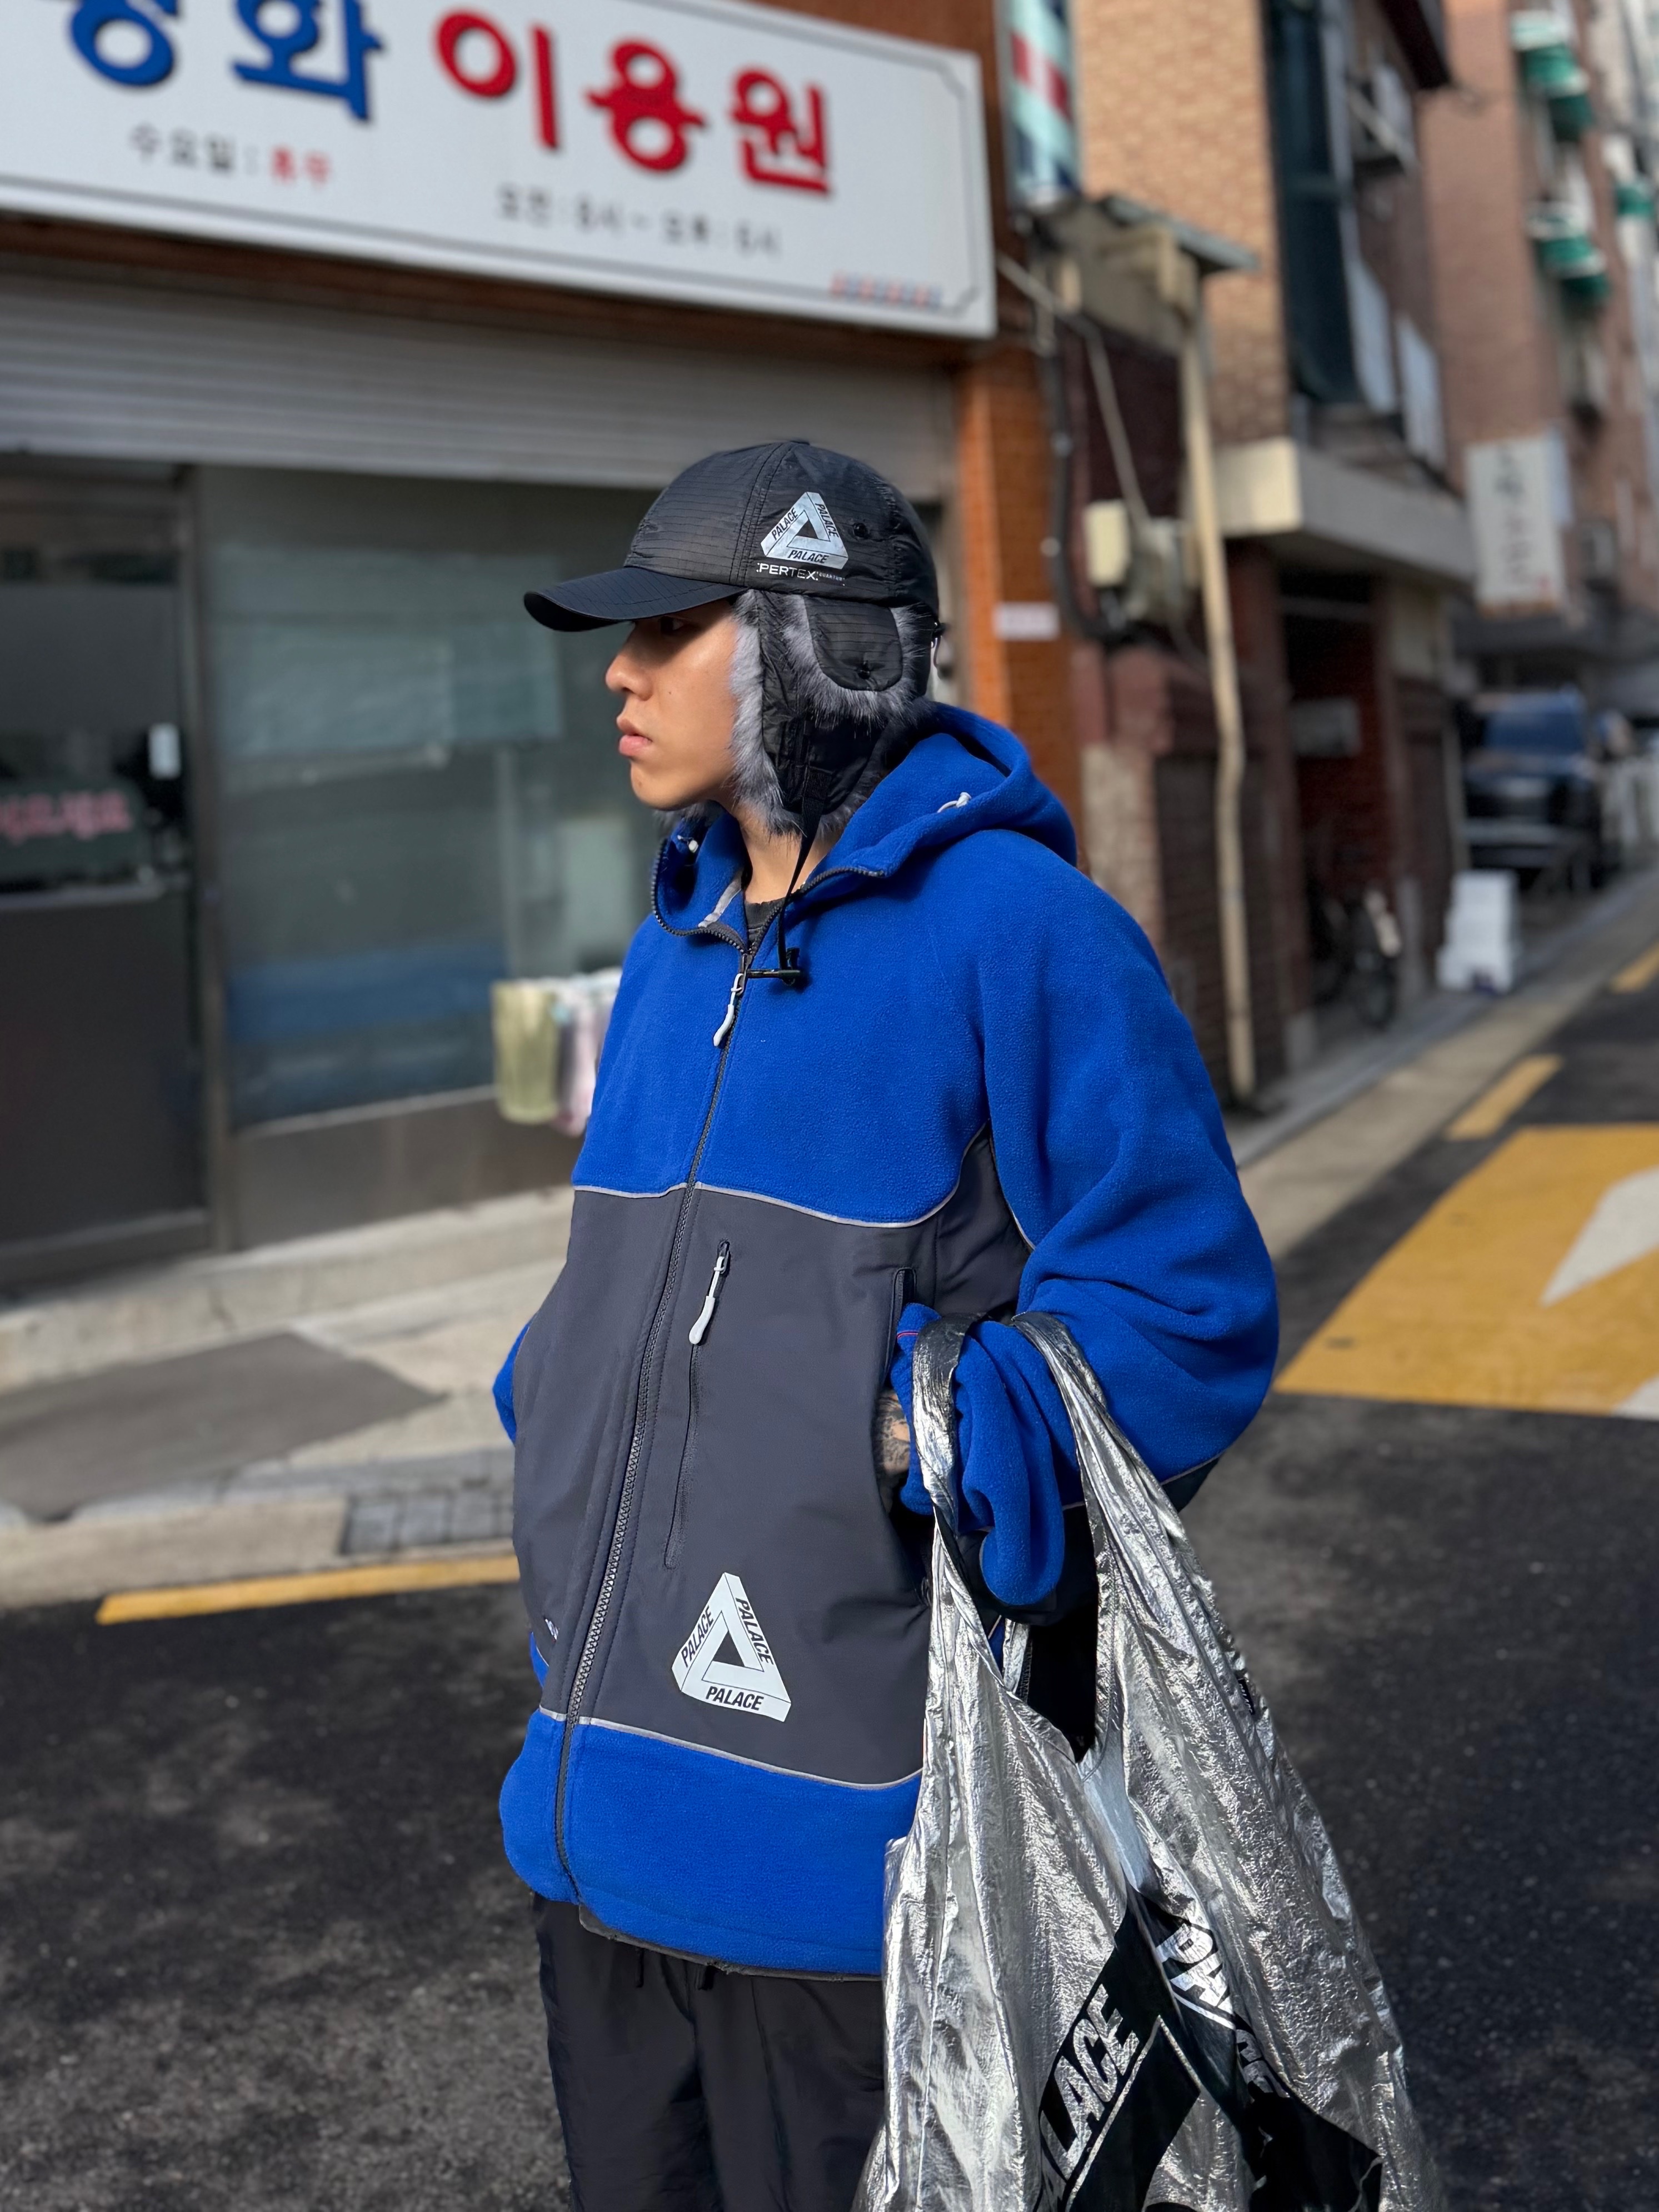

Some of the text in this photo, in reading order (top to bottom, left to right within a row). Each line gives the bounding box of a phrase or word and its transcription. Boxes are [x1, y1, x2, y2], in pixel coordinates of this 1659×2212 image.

[436, 10, 829, 194] 이용원
[771, 507, 799, 541] PALACE
[814, 503, 839, 538] PALACE
[788, 549, 829, 564] PALACE
[681, 1605, 714, 1668] PALACE
[735, 1597, 774, 1666] PALACE
[706, 1685, 764, 1711] PALACE
